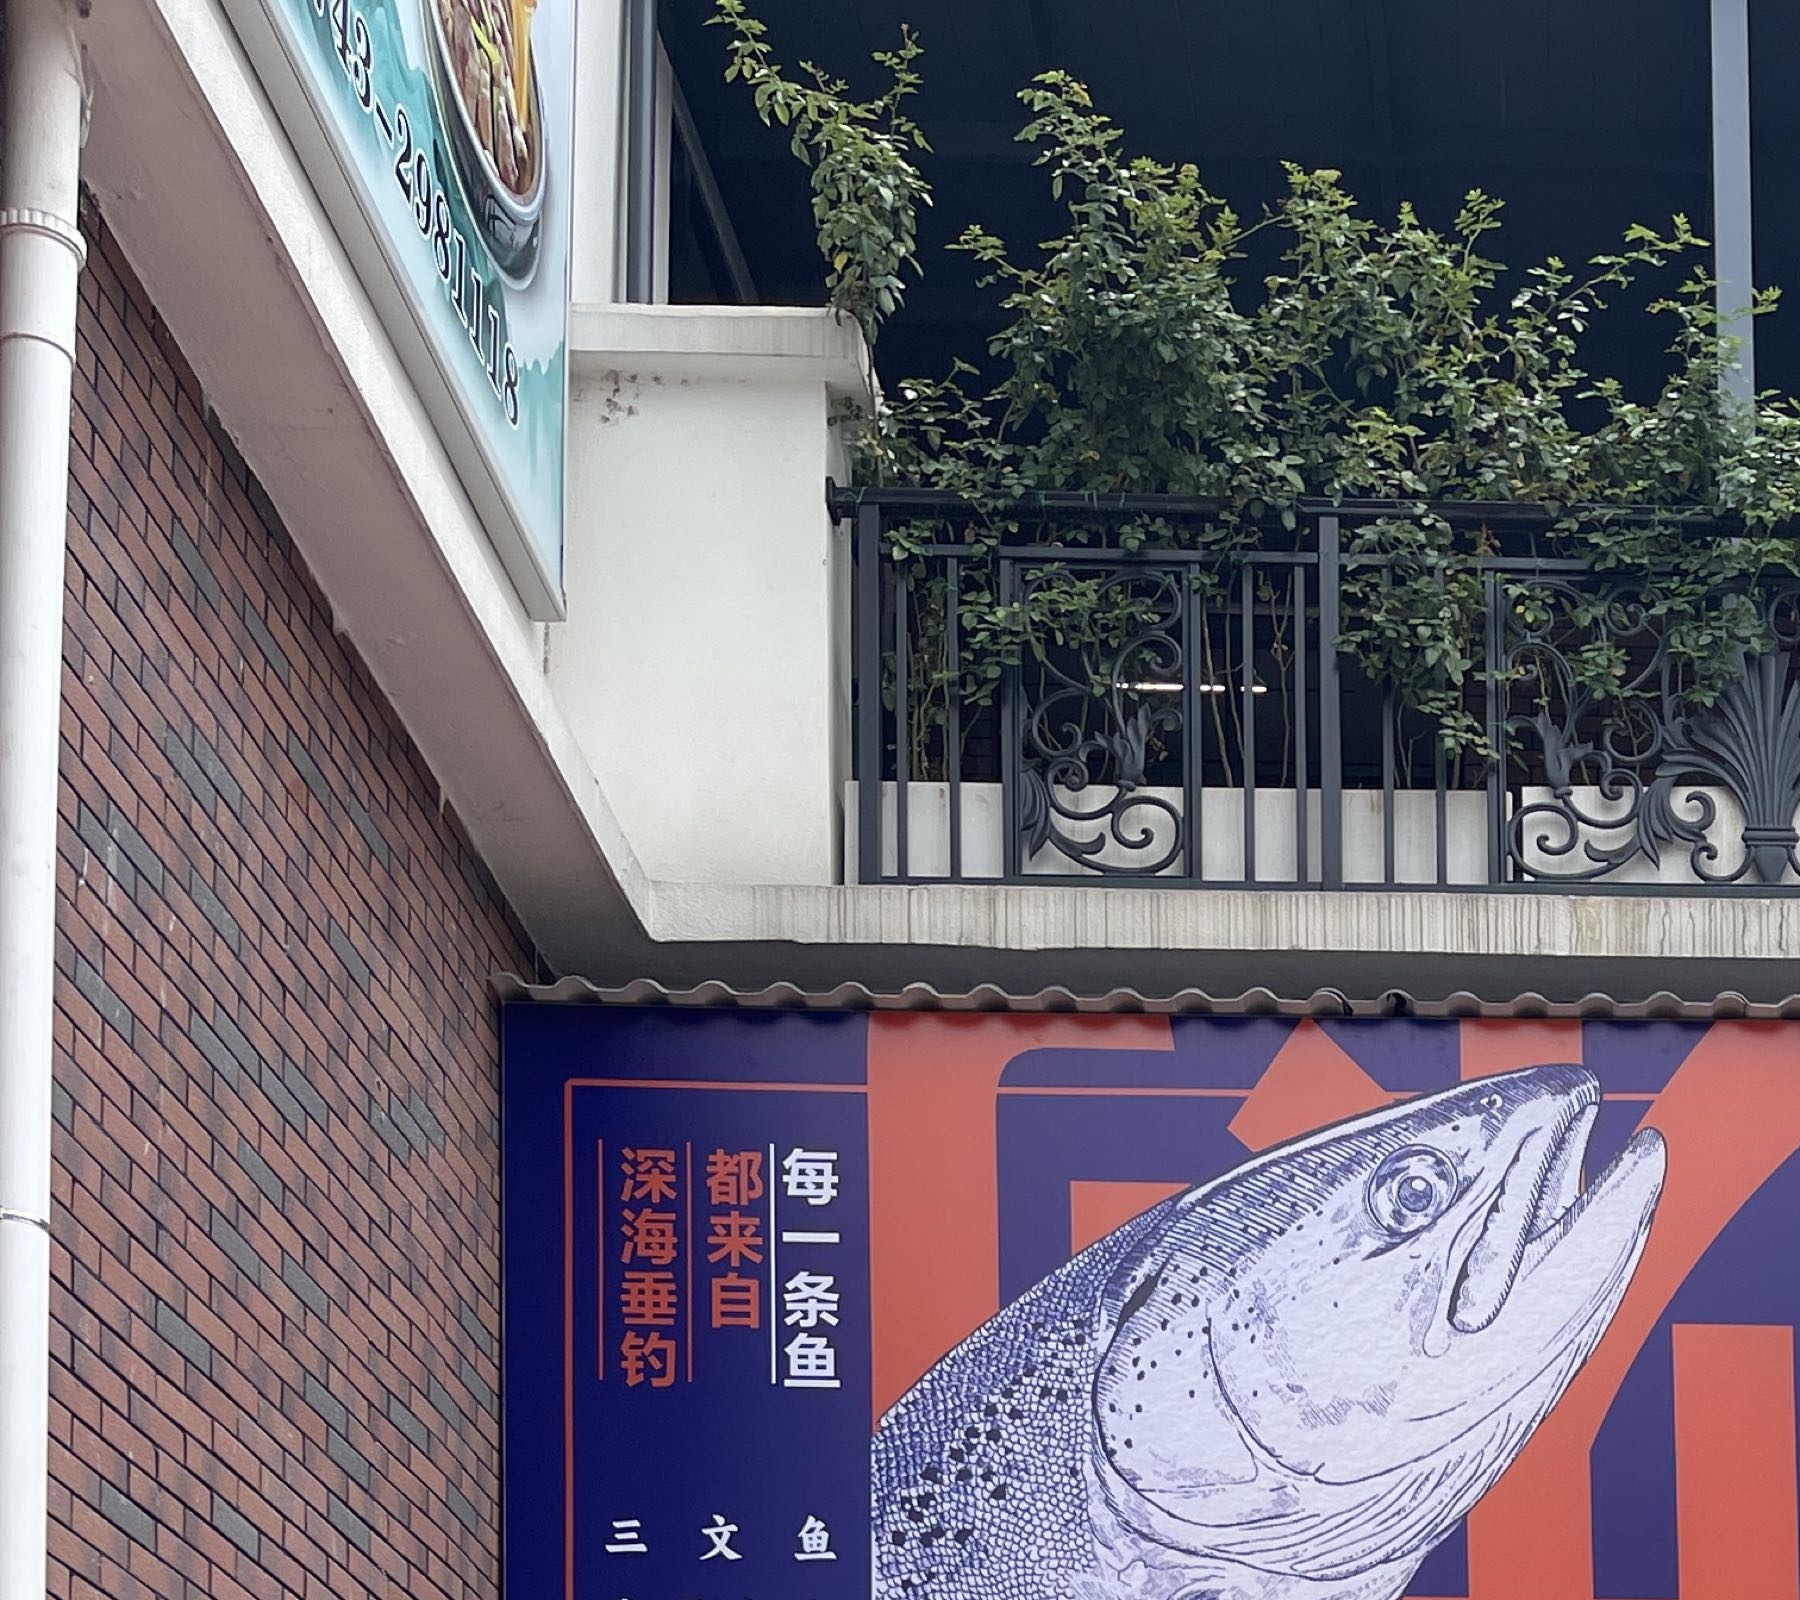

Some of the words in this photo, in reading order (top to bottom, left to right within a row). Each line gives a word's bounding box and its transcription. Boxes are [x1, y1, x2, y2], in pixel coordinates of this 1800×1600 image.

[313, 0, 520, 428] 43-2981118
[619, 1146, 679, 1389] 深海垂钓
[706, 1147, 764, 1330] 都来自
[782, 1146, 842, 1389] 每一条鱼
[605, 1514, 838, 1561] 三文鱼
